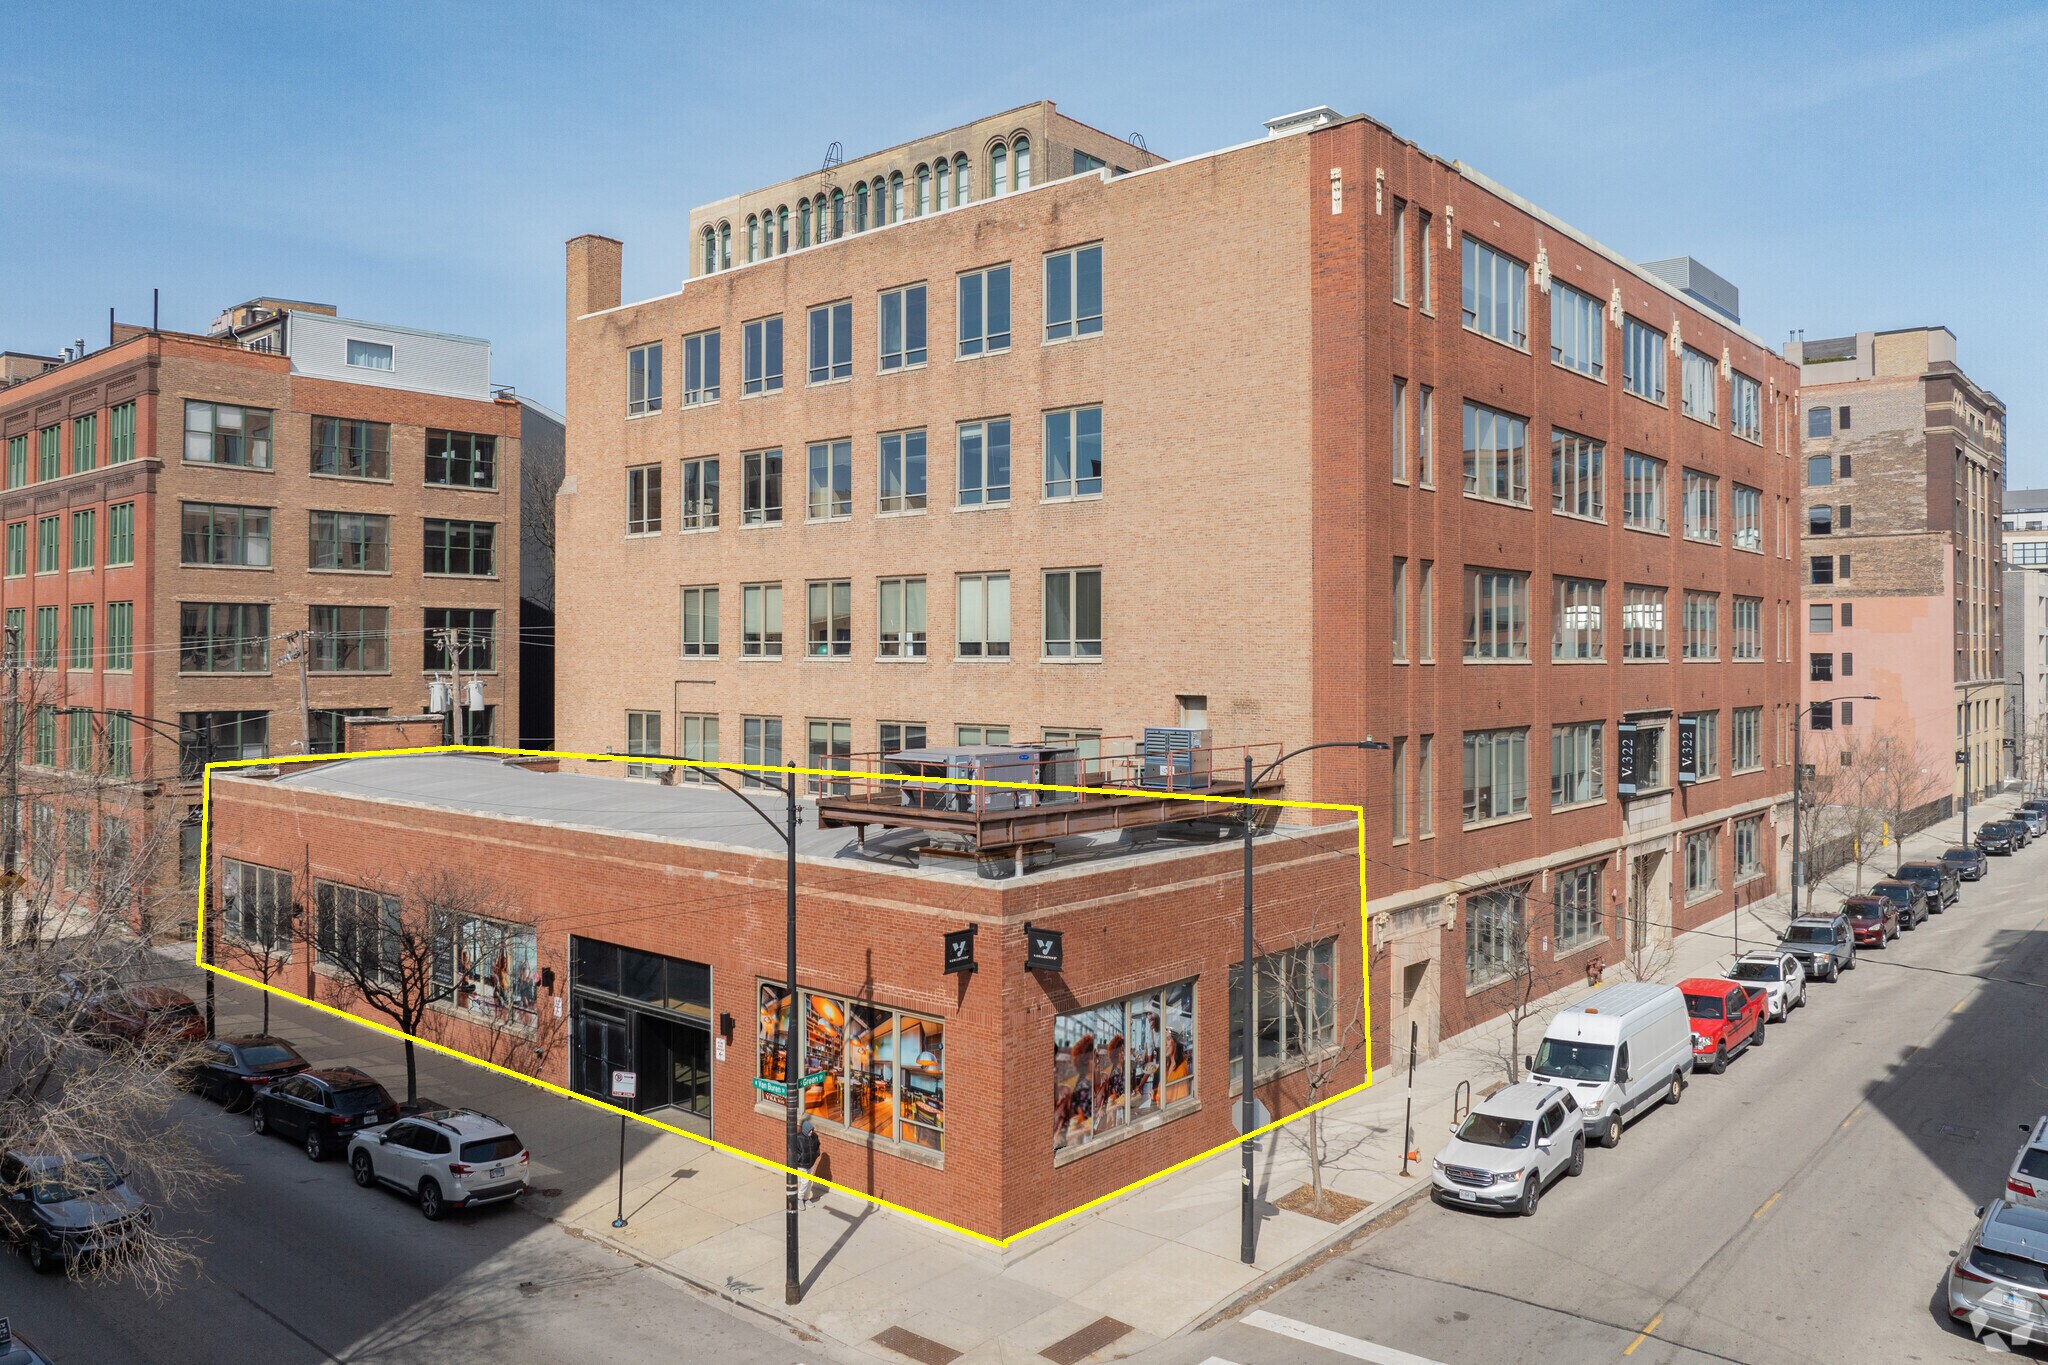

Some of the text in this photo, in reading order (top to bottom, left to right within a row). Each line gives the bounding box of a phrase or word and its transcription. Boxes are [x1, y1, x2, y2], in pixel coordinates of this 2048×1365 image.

[1622, 739, 1633, 777] V.322
[1682, 731, 1693, 766] V.322
[758, 1080, 767, 1088] Van
[767, 1082, 781, 1093] Buren
[803, 1076, 818, 1086] Green
